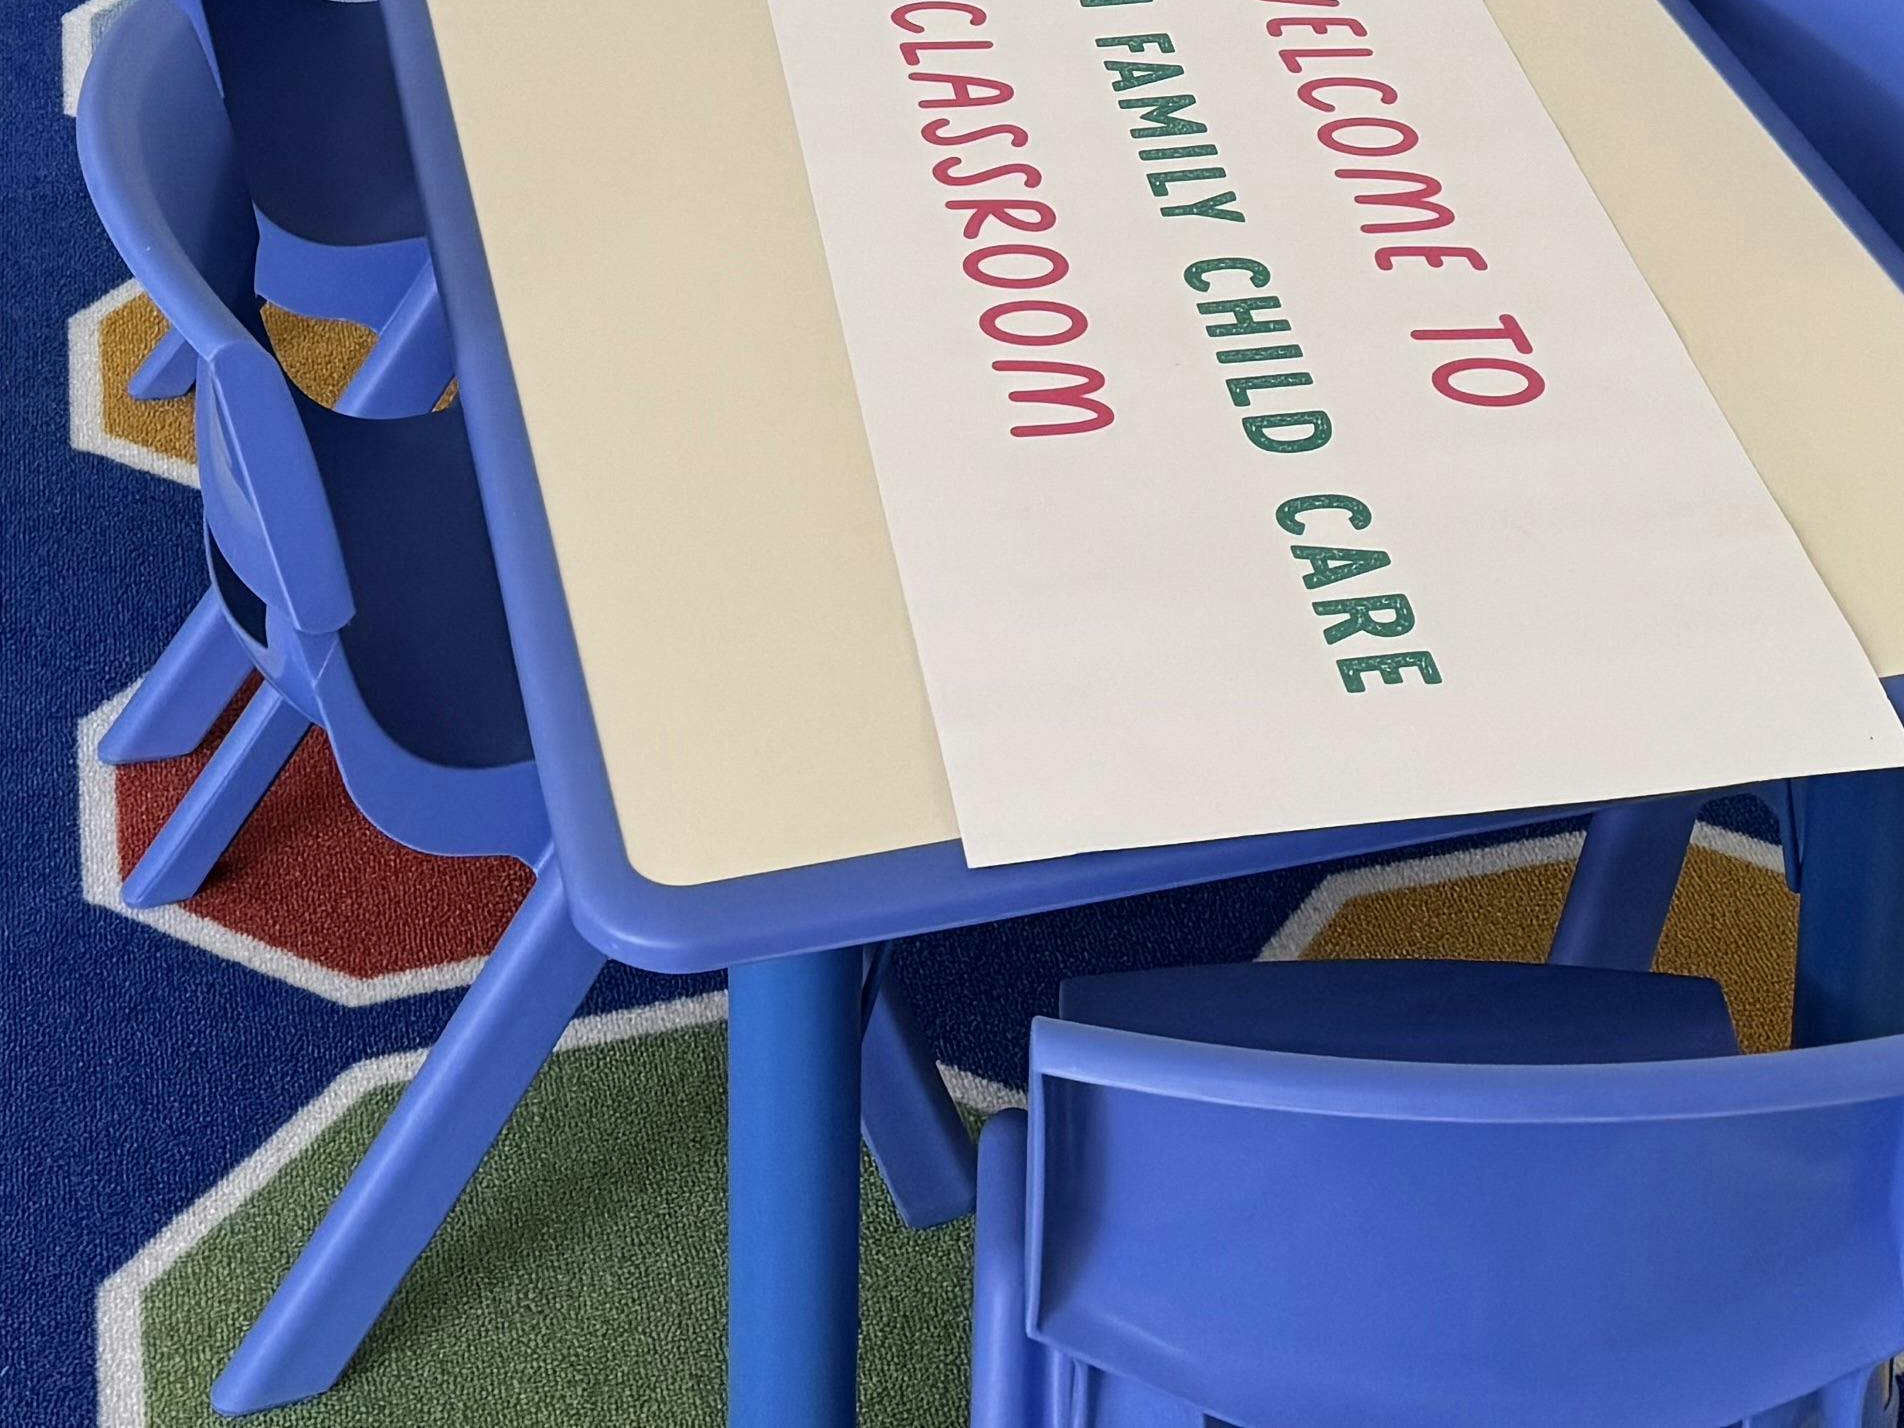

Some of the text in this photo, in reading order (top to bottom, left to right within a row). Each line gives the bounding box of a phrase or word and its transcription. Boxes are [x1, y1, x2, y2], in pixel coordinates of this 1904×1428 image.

[1095, 31, 1247, 224] FAMILY
[1183, 256, 1334, 455] CHILD
[1275, 491, 1443, 693] CARE
[1411, 312, 1546, 407] TO
